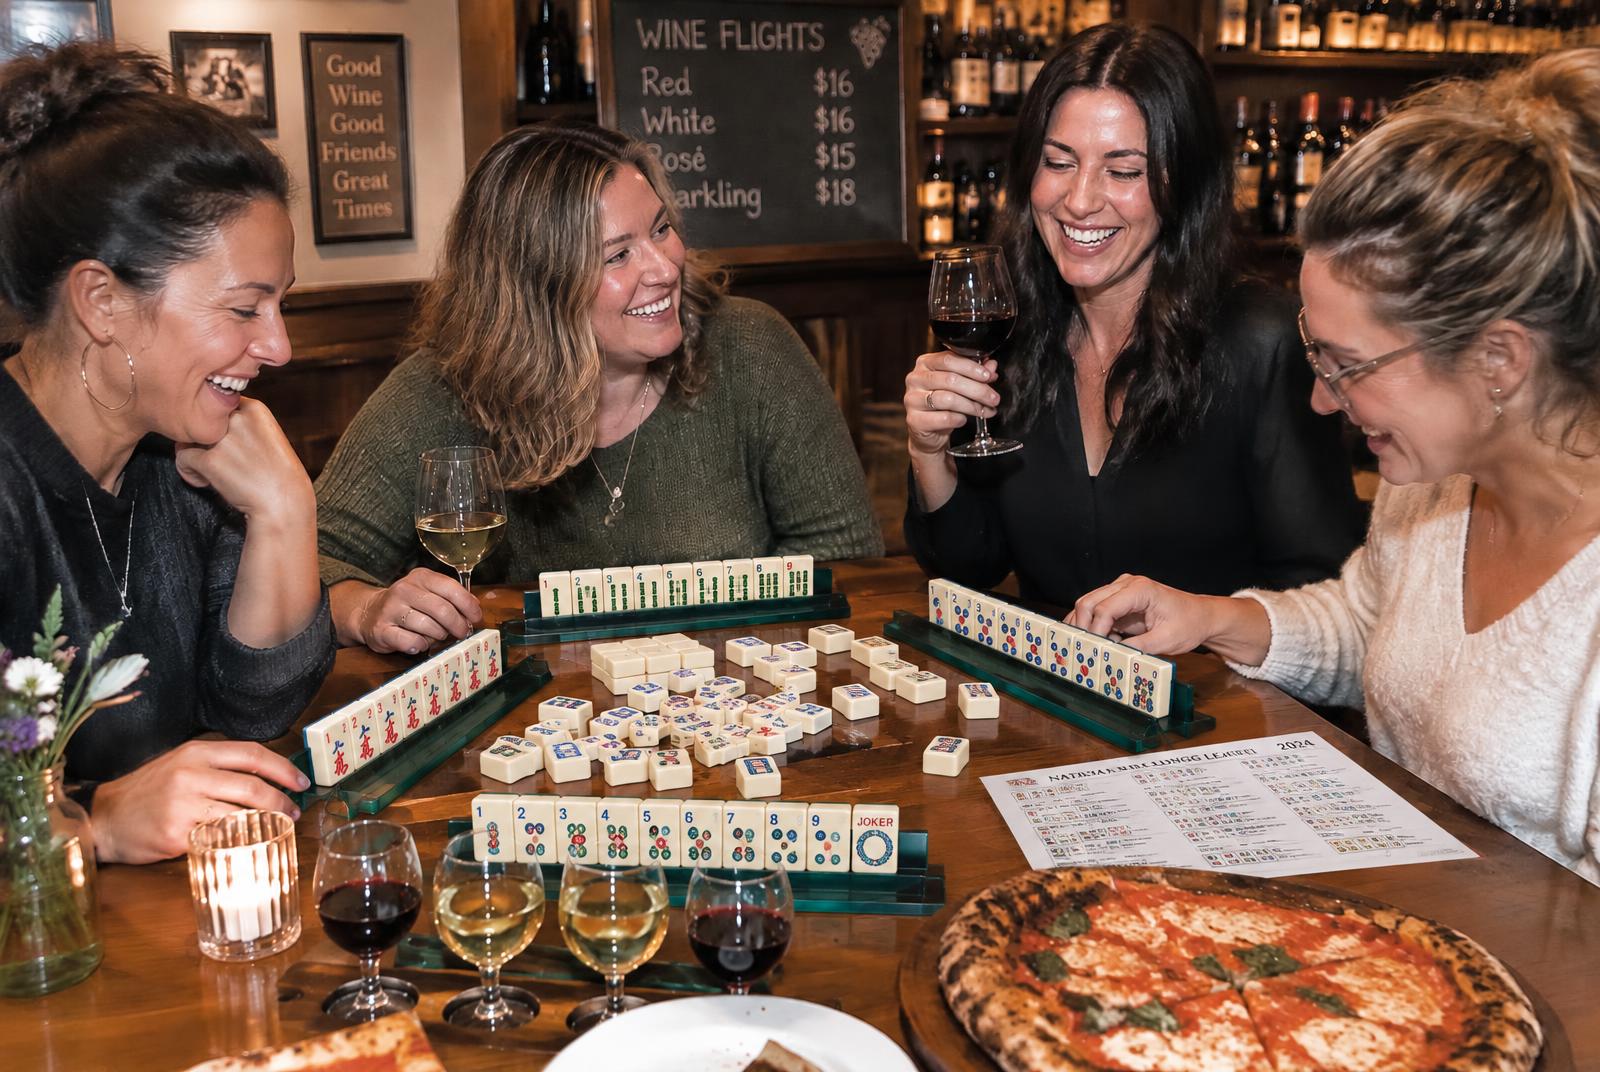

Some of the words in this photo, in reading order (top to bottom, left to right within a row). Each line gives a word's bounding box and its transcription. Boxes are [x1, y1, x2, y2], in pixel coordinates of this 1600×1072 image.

[636, 18, 708, 50] WINE
[719, 19, 826, 52] FLIGHTS
[326, 53, 383, 78] Good
[640, 65, 693, 97] Red
[814, 66, 855, 98] $16
[328, 84, 384, 107] Wine
[330, 112, 385, 135] Good
[641, 104, 717, 136] White
[814, 103, 856, 135] $16
[321, 141, 397, 163] Friends
[815, 141, 856, 171] $15
[333, 170, 390, 193] Great
[674, 180, 762, 219] arkling
[815, 176, 857, 207] $18
[333, 198, 393, 221] Times
[696, 568, 703, 577] 6
[726, 565, 733, 575] 7
[786, 561, 793, 571] 9
[575, 576, 581, 586] 2
[952, 594, 957, 603] 2
[1050, 630, 1056, 641] 7
[1133, 662, 1140, 674] 9
[377, 702, 383, 713] 3
[352, 716, 358, 729] 2
[1276, 739, 1316, 751] 2024
[476, 806, 483, 818] 1
[517, 806, 526, 819] 2
[559, 807, 568, 820] 3
[601, 809, 610, 821] 4
[643, 810, 651, 822] 5
[685, 811, 694, 824] 6
[726, 812, 735, 825] 7
[770, 813, 779, 826] 8
[811, 814, 820, 827] 9
[857, 817, 893, 828] JOKER
